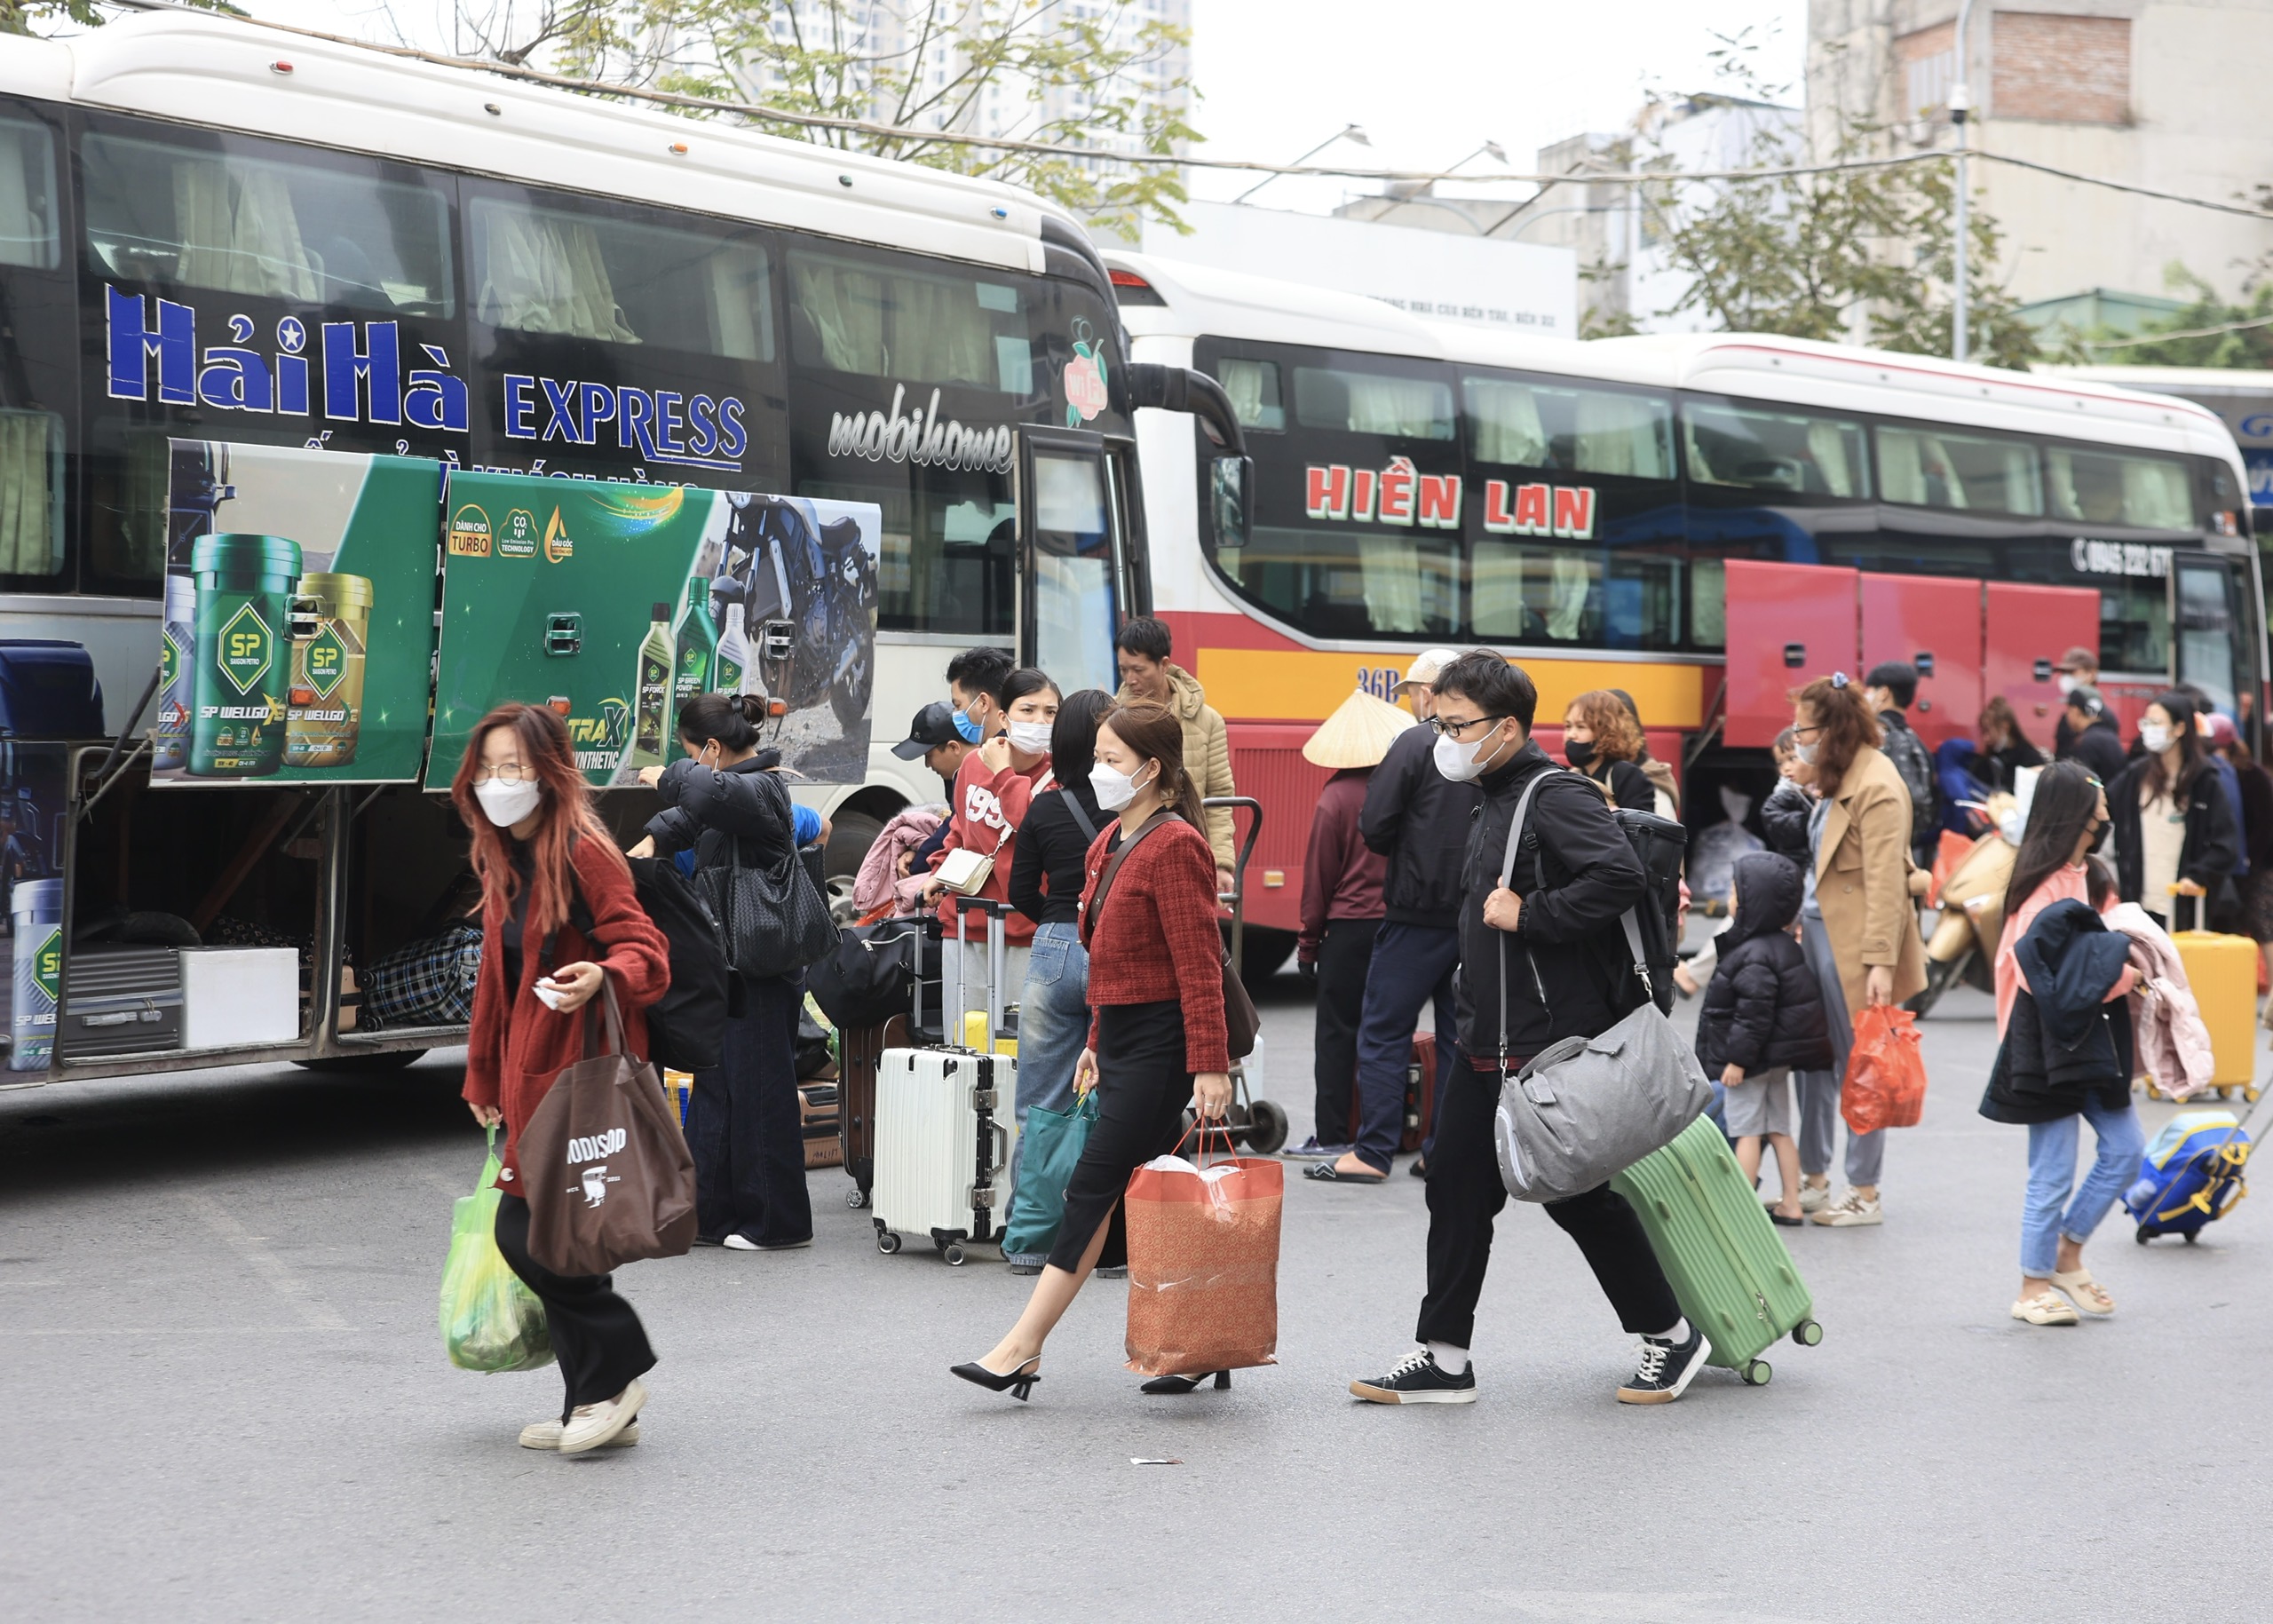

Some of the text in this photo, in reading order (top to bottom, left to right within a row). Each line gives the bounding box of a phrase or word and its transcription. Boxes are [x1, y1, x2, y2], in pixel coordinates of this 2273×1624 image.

[503, 373, 748, 471] EXPRESS
[828, 383, 1016, 474] mobihome
[1306, 455, 1596, 540] HIỀN LAN
[455, 519, 487, 533] DÀNH CHO
[452, 535, 488, 553] TURBO
[502, 544, 535, 553] TECHNOLOGY
[231, 633, 260, 657] SP
[313, 647, 337, 668] SP
[1357, 668, 1400, 704] 36B
[200, 706, 218, 719] SP
[219, 706, 270, 719] WELLGO
[287, 710, 303, 721] SP
[304, 709, 345, 721] WELLGO
[573, 751, 619, 769] YNTHETIC
[15, 1016, 32, 1026] SP
[567, 1128, 627, 1164] ODISOP
